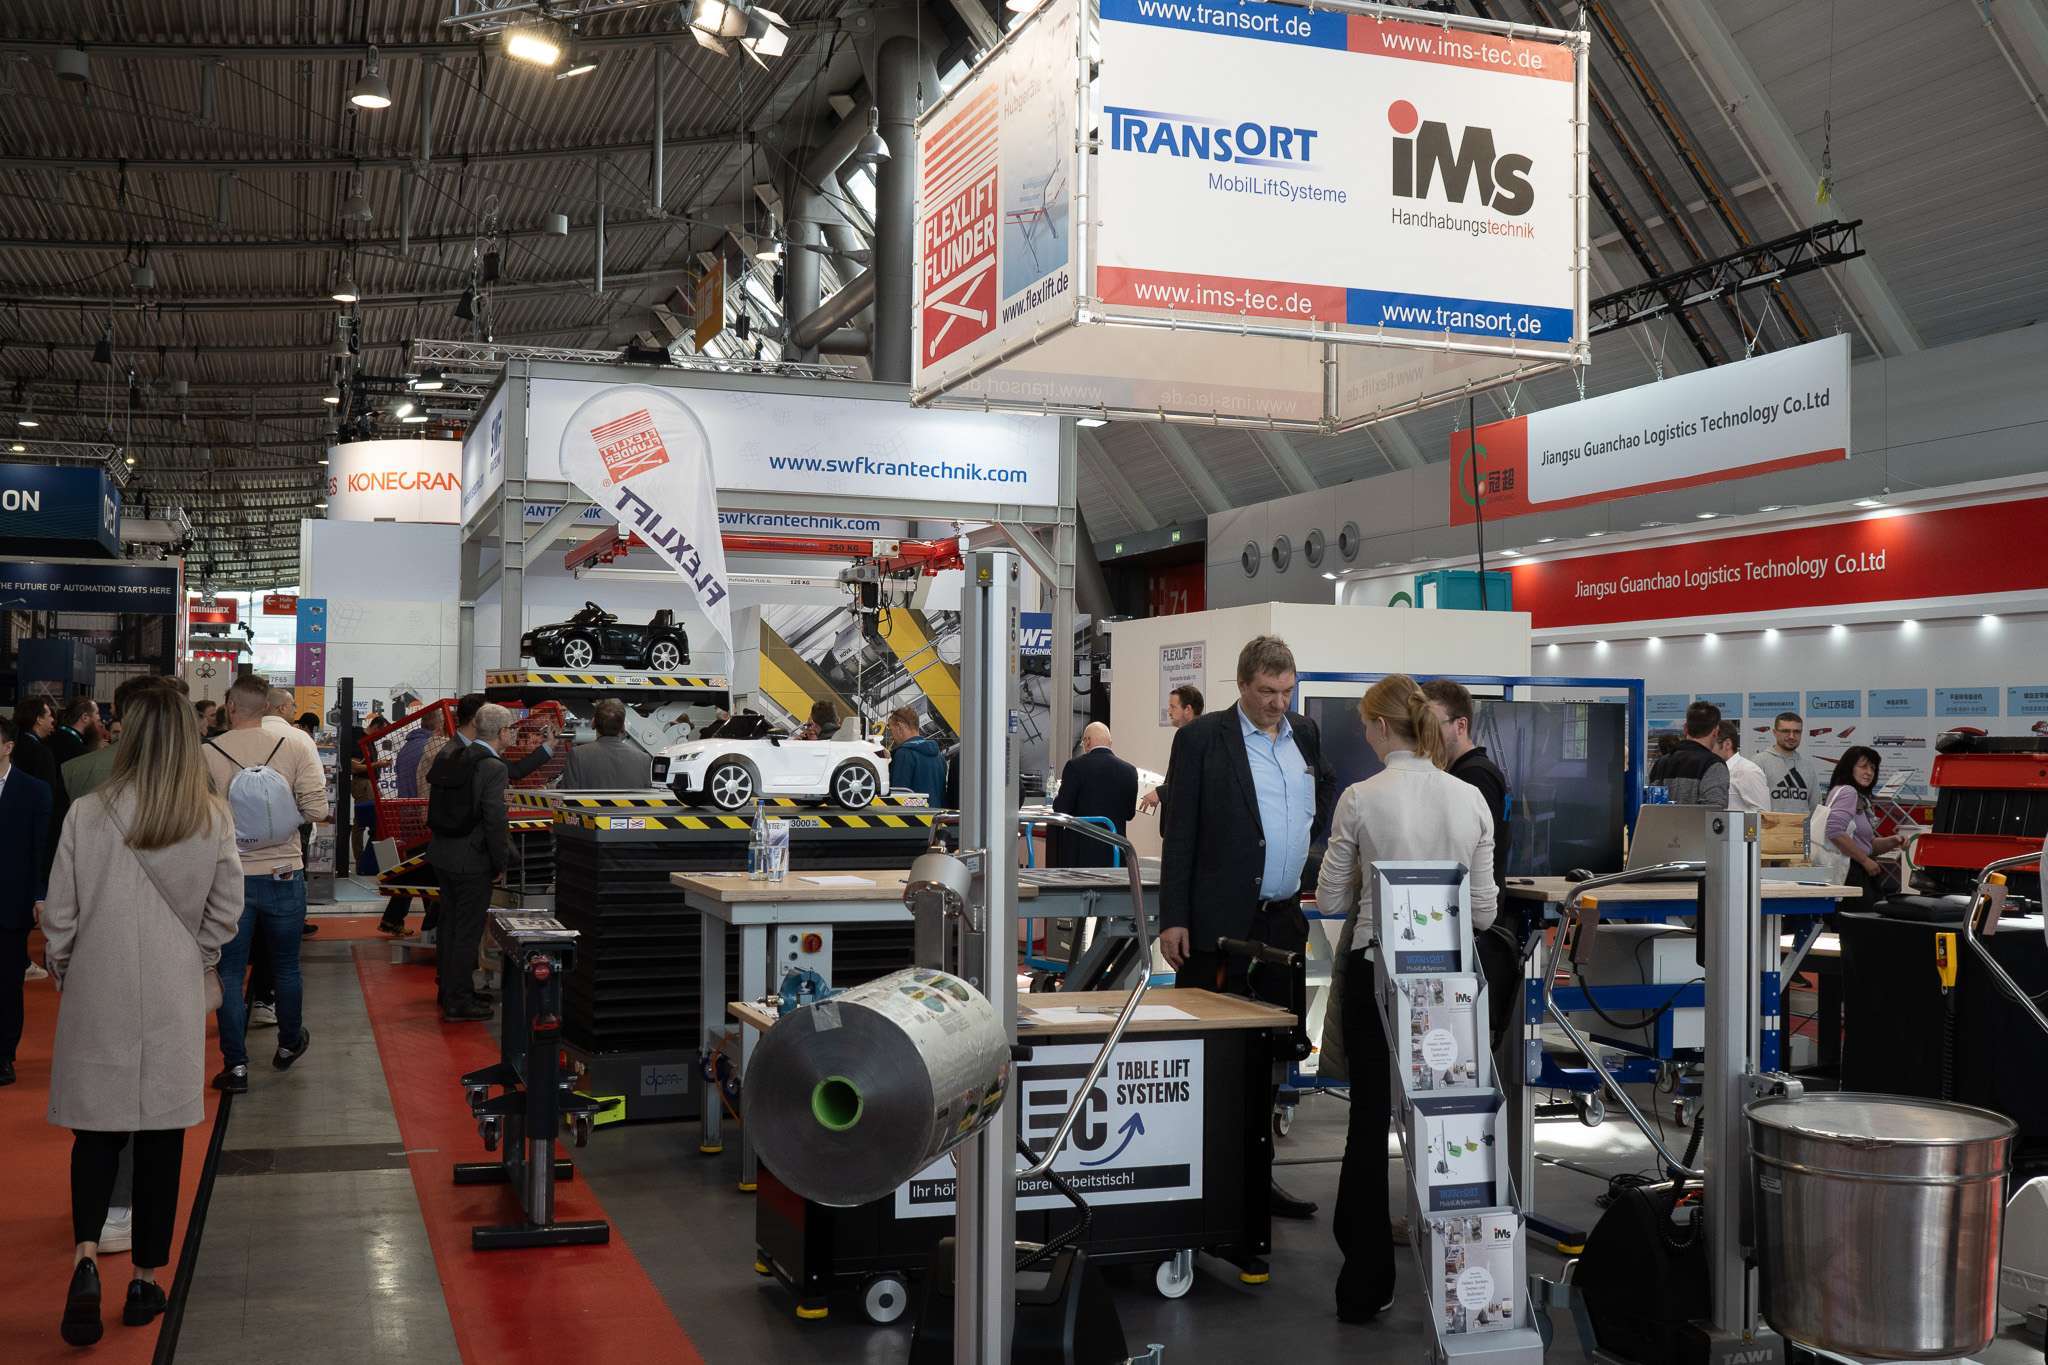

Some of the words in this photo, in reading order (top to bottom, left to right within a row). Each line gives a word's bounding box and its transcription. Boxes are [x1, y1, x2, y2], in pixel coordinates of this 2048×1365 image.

[1138, 0, 1312, 37] www.transort.de
[1381, 32, 1543, 70] www.ims-tec.de
[1208, 172, 1347, 204] MobilLiftSysteme
[925, 171, 997, 255] FLEXLIFT
[1391, 207, 1535, 240] Handhabungstechnik
[925, 213, 996, 291] FLUNDER
[1002, 271, 1069, 325] www.flexlift.de
[1134, 282, 1313, 314] www.ims-tec.de
[1382, 304, 1542, 334] www.transort.de
[1541, 447, 1581, 467] Jiangsu
[1583, 432, 1641, 458] Guanchao
[1644, 420, 1698, 448] Logistics
[1700, 402, 1779, 434] Technology
[1783, 388, 1830, 415] Co.Ltd
[769, 456, 1027, 483] www.swfkrantechnik.com
[15, 582, 48, 591] FUTURE
[50, 583, 61, 591] OF
[63, 584, 116, 593] AUTOMATION
[118, 585, 148, 594] STARTS
[150, 586, 172, 595] HERE
[1575, 580, 1617, 600] Jiangsu
[1619, 572, 1681, 593] Guanchao
[1684, 563, 1741, 590] Logistics
[1744, 555, 1828, 580] Technology
[1834, 548, 1886, 574] Co.Ltd
[1020, 629, 1052, 646] WF
[1163, 647, 1193, 662] FLEXLIFT
[1771, 788, 1808, 801] adida
[791, 819, 811, 828] 3000
[1116, 1060, 1159, 1082] TABLE
[1163, 1058, 1190, 1078] LIFT
[1116, 1080, 1190, 1106] SYSTEMS
[913, 1184, 932, 1198] Ihr
[1722, 1349, 1773, 1365] TAWI
